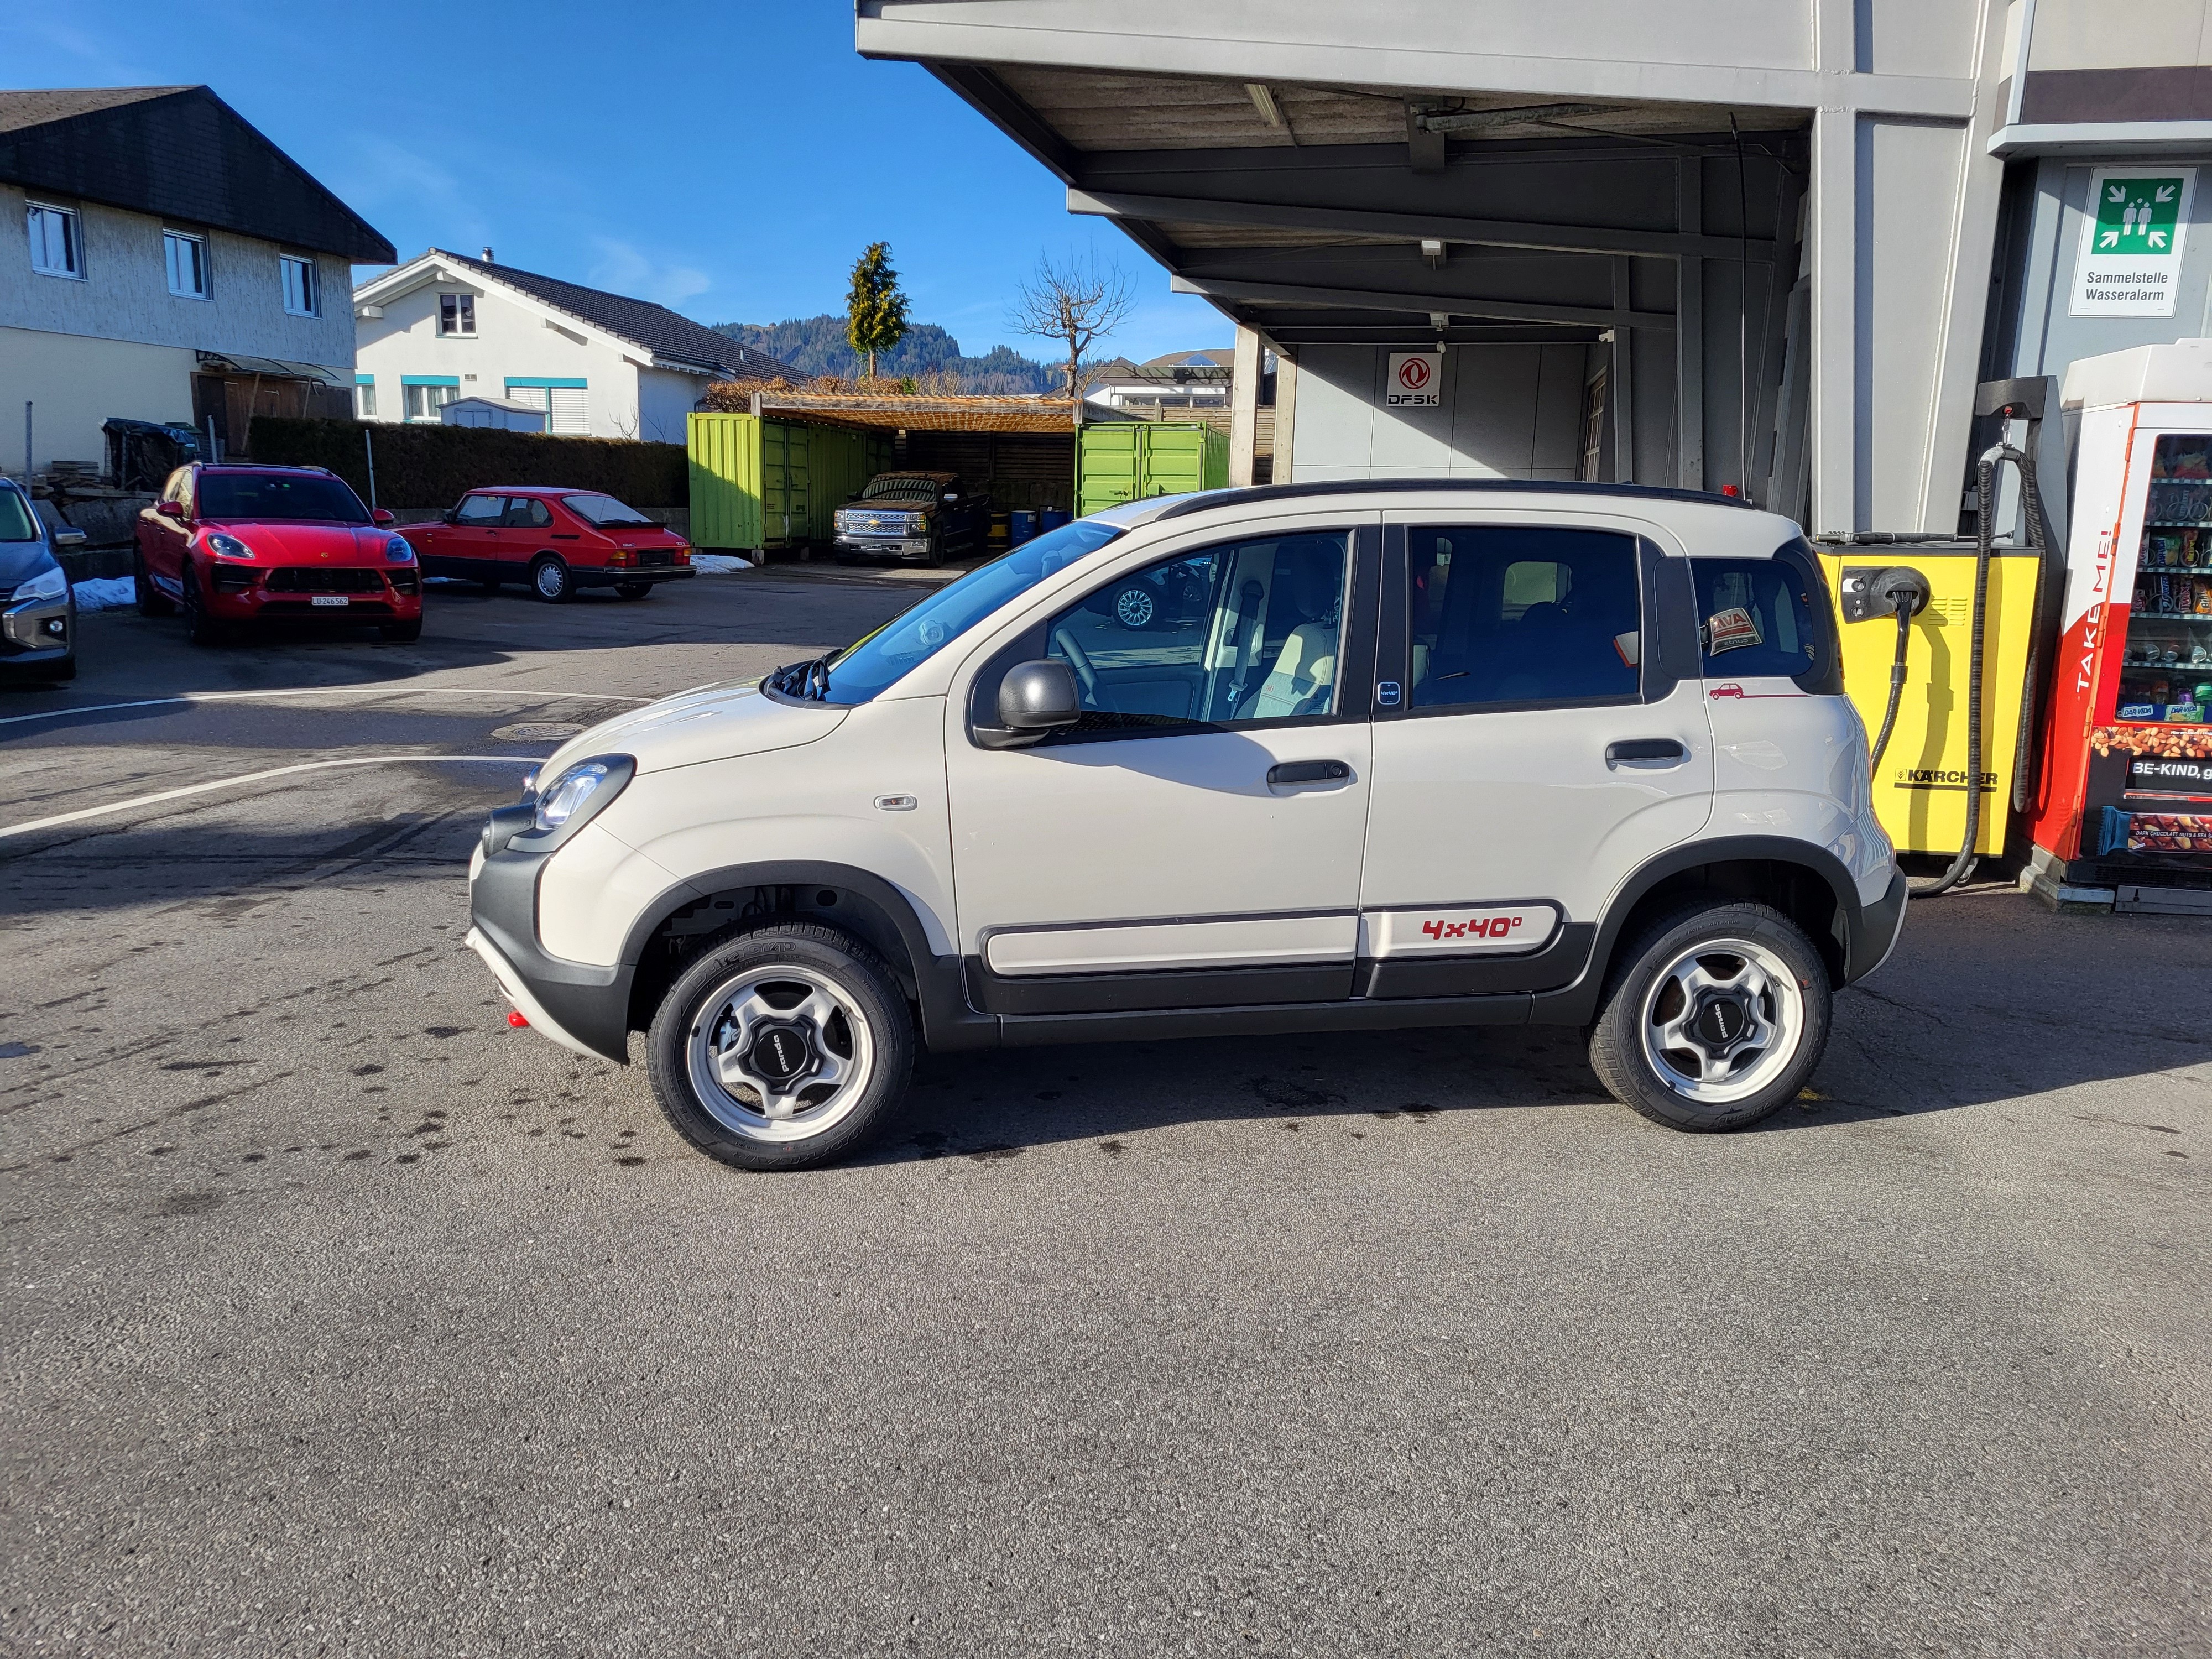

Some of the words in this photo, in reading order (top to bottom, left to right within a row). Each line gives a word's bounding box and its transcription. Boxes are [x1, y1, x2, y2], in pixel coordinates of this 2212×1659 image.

[2087, 272, 2168, 283] Sammelstelle
[2086, 289, 2164, 300] Wasseralarm
[1388, 394, 1438, 404] DFSK
[2077, 605, 2100, 693] TAKE
[2093, 530, 2111, 592] ME!
[2133, 763, 2201, 779] BE-KIND,
[1715, 1004, 1728, 1038] panda
[773, 1035, 790, 1072] panda
